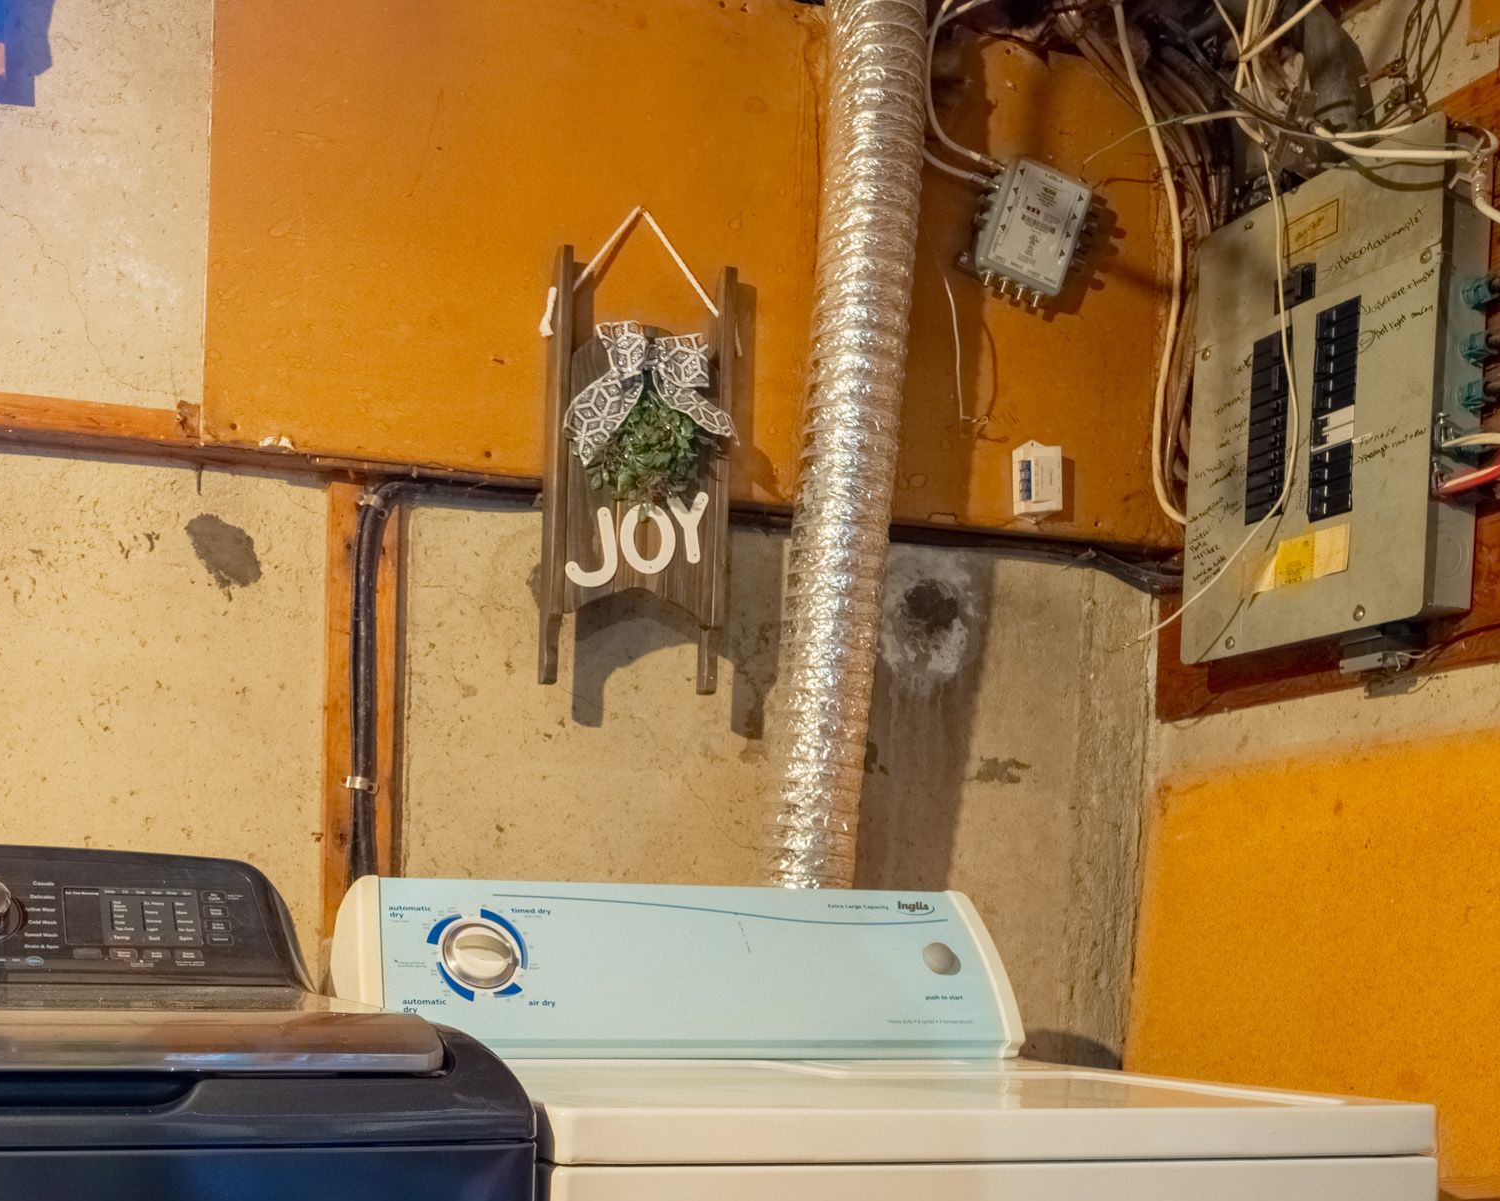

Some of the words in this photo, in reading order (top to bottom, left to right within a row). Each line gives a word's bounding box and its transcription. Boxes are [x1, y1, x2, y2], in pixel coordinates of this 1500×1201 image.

[564, 491, 710, 588] JOY
[897, 900, 930, 913] Inglis
[389, 911, 404, 919] dry
[537, 908, 551, 916] dry
[402, 998, 447, 1006] automatic
[541, 999, 556, 1007] dry
[403, 1006, 418, 1014] dry
